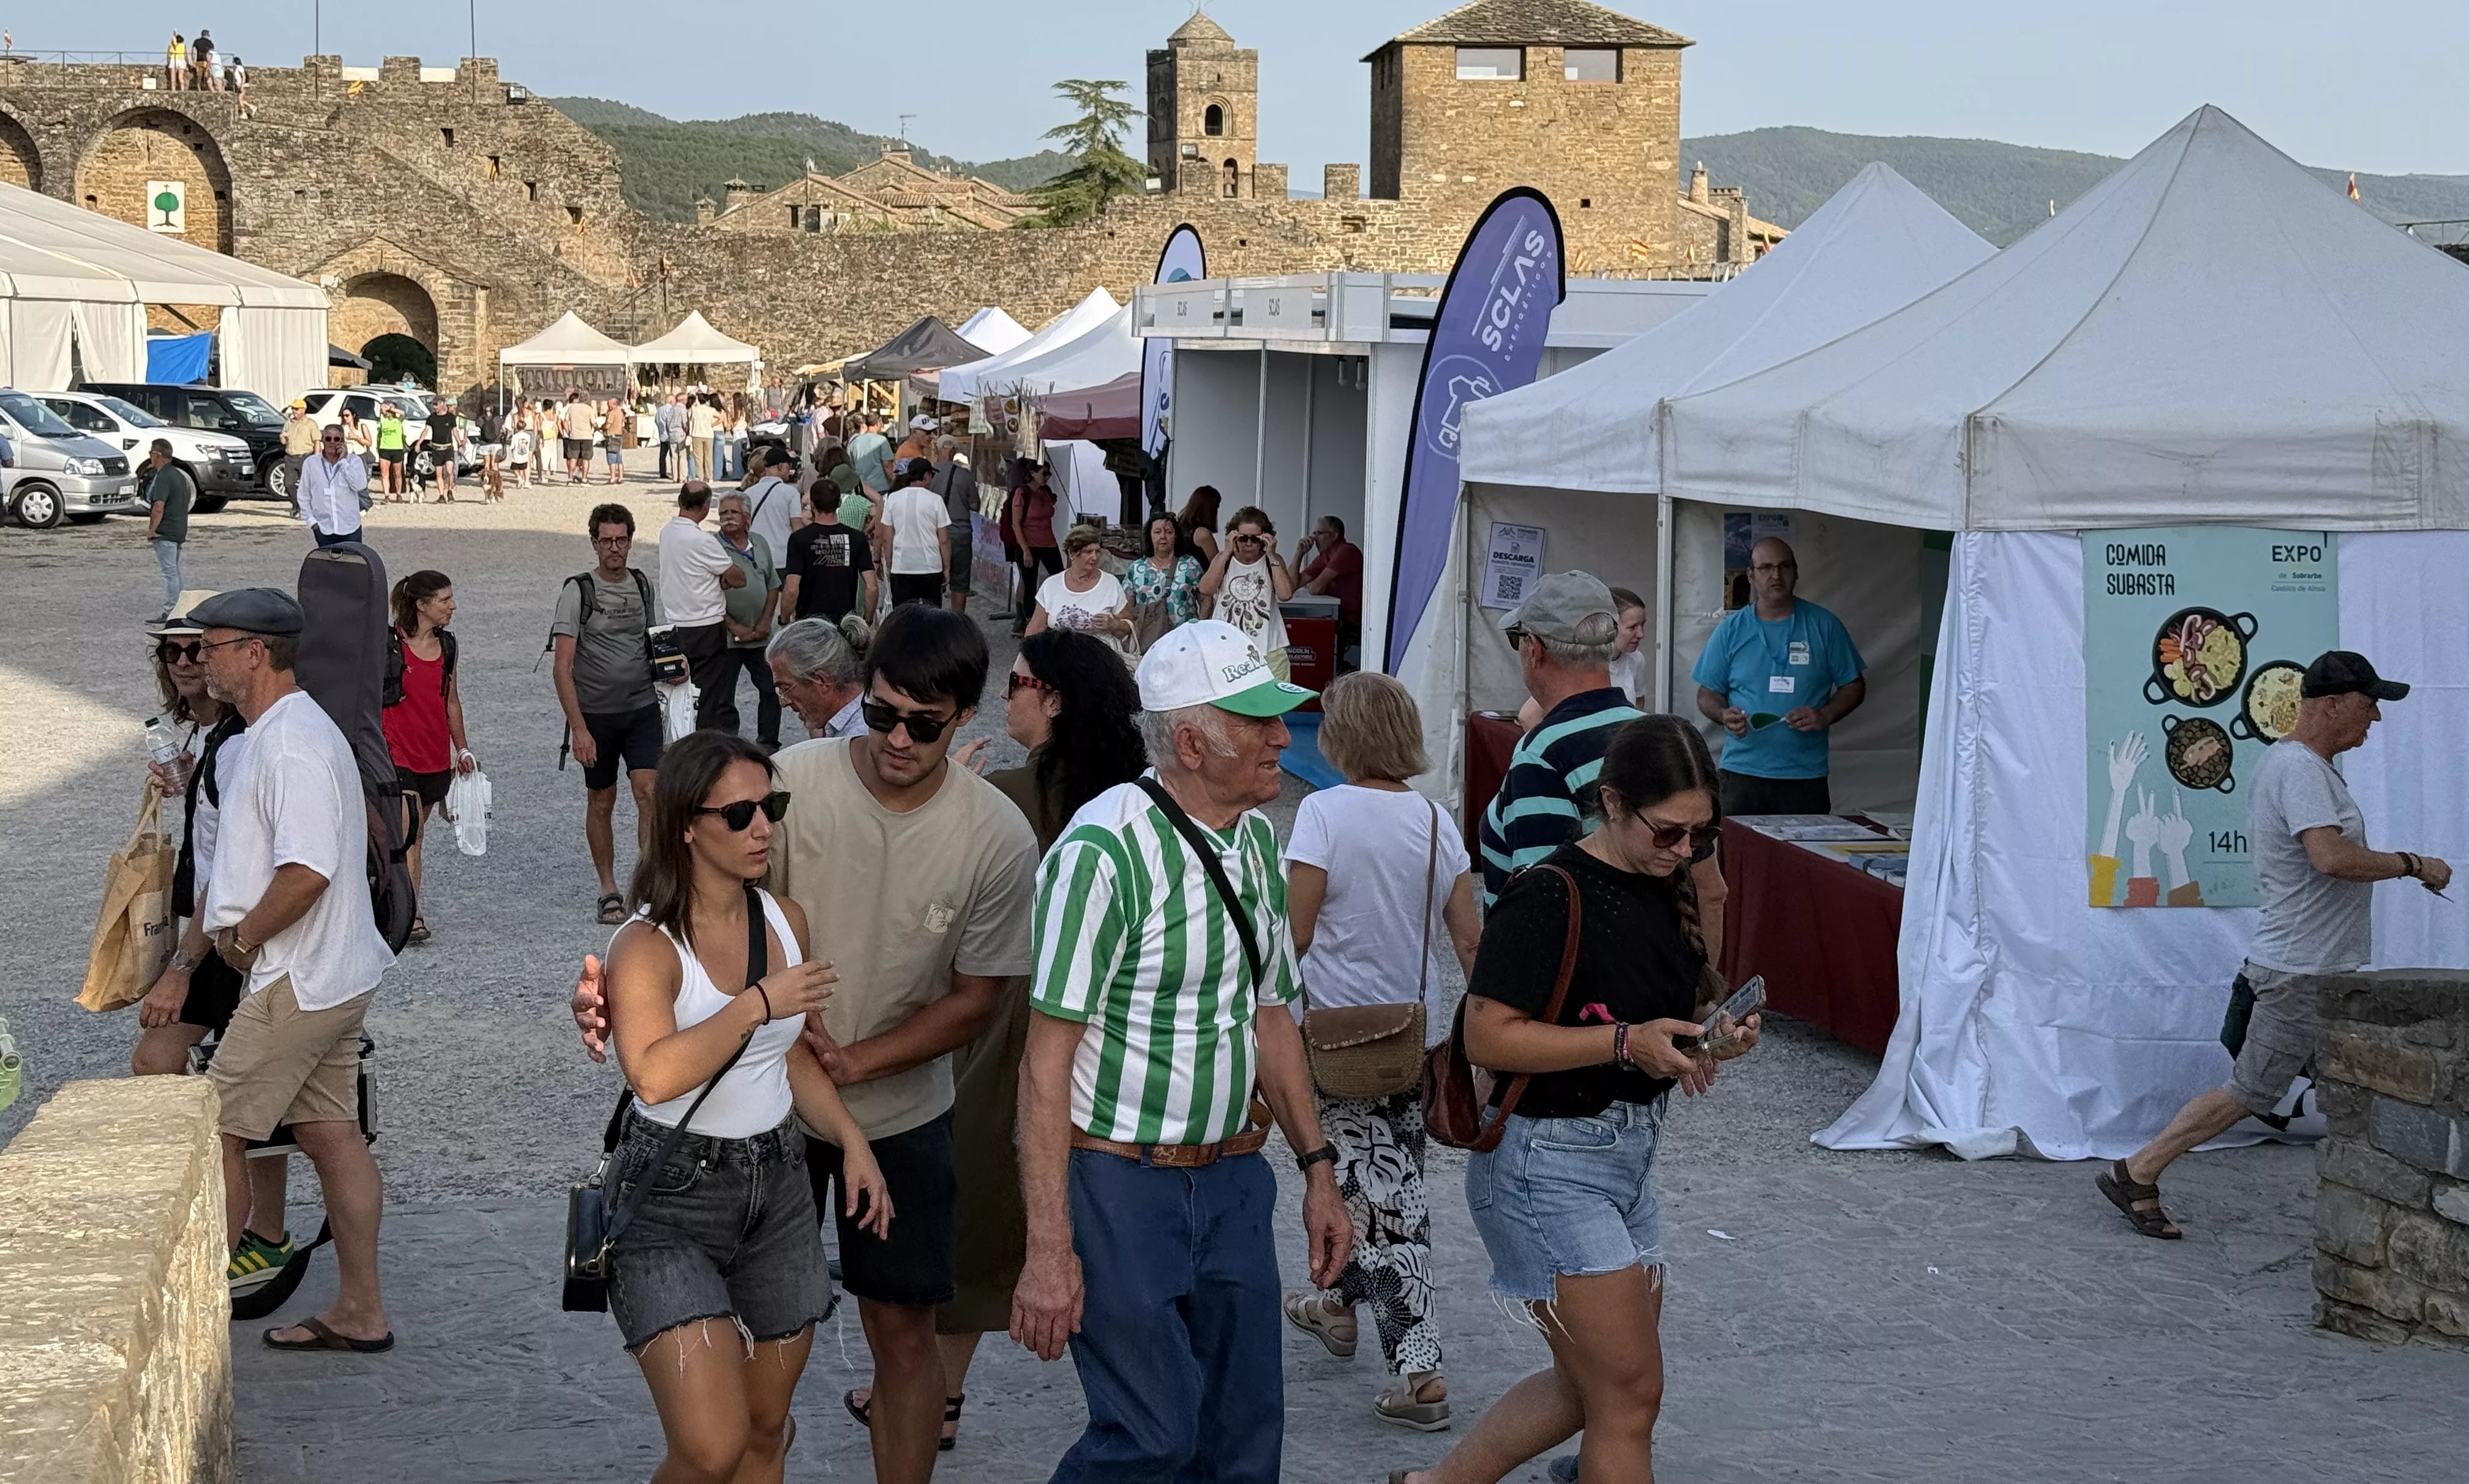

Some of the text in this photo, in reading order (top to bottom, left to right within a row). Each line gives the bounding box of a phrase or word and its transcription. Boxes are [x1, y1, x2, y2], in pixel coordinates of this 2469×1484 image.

[1482, 230, 1545, 352] SCLAS
[1493, 552, 1534, 563] DESCARGA
[2106, 544, 2166, 566] COMIDA
[2272, 545, 2321, 562] EXPO
[2107, 573, 2174, 595] SUBASTA
[2209, 830, 2247, 853] 14h
